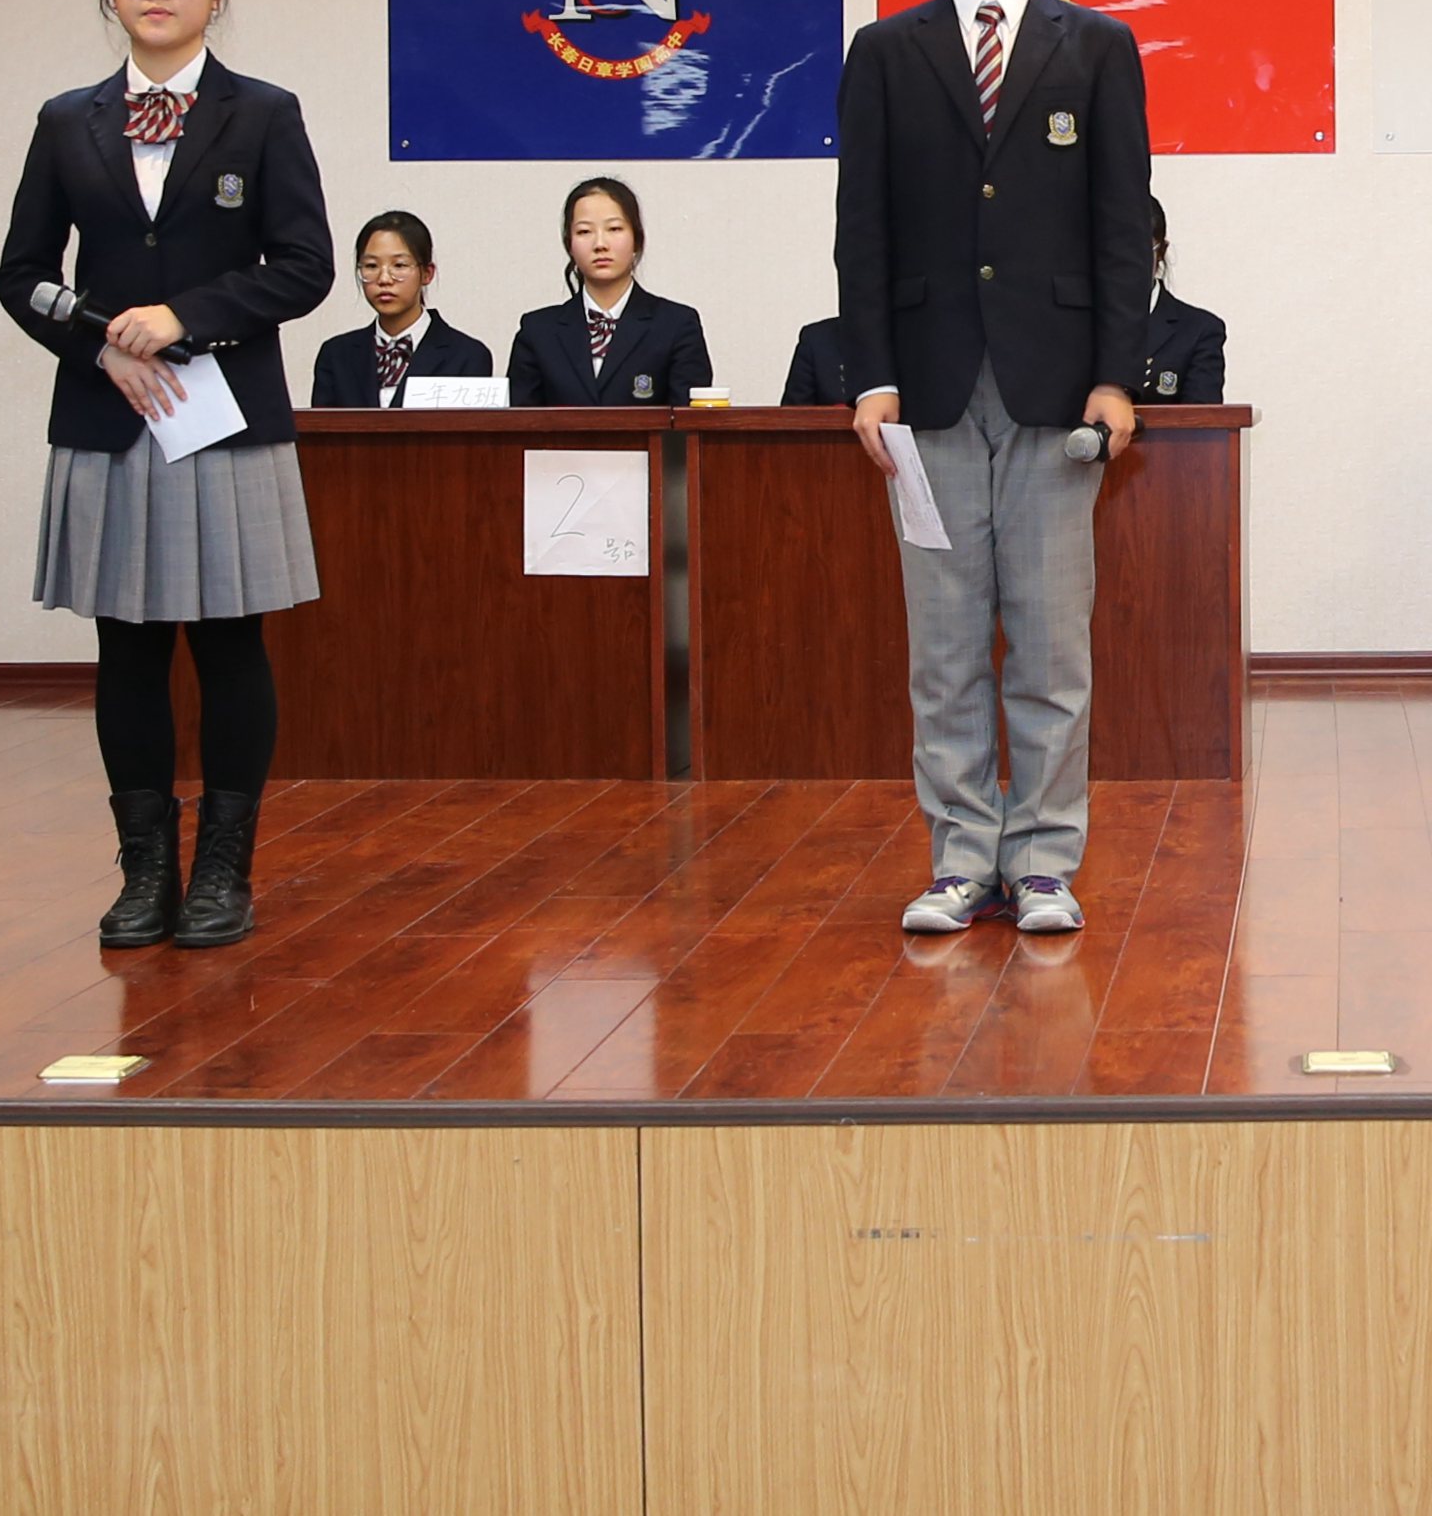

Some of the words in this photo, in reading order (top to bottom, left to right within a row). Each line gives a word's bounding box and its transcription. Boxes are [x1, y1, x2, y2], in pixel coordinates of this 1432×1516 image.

[411, 383, 501, 408] 一年九班
[550, 474, 585, 538] 2
